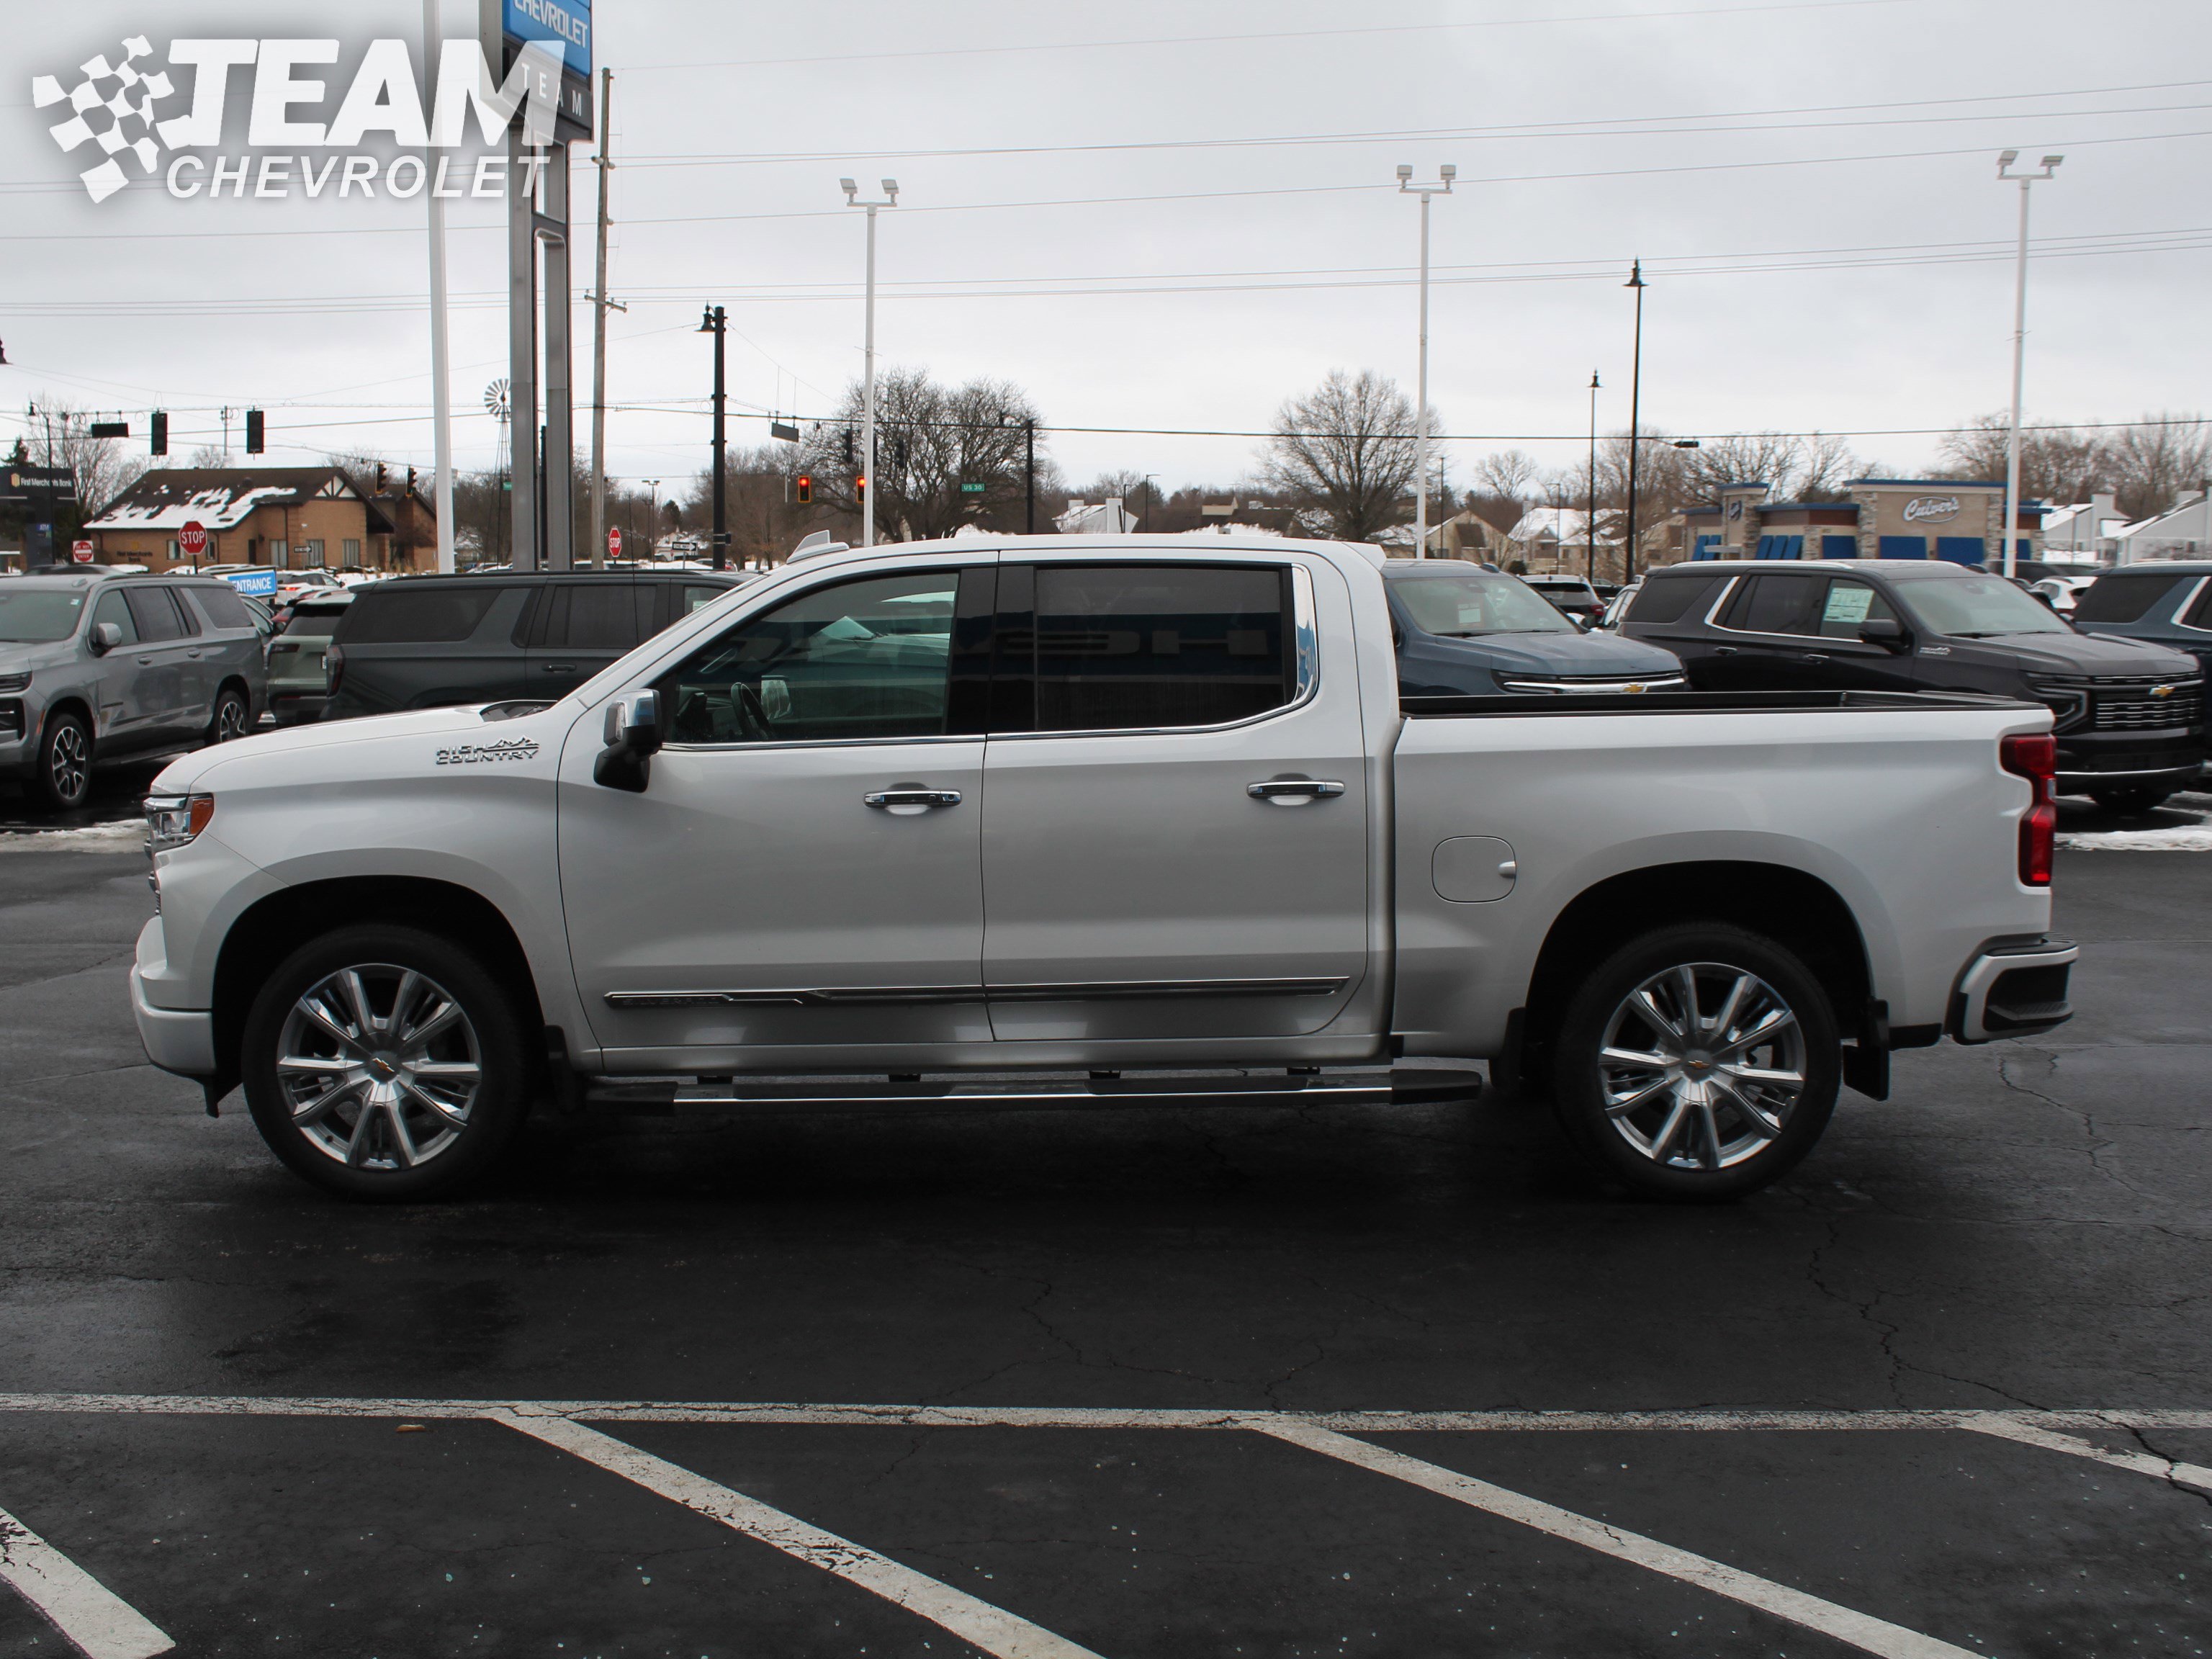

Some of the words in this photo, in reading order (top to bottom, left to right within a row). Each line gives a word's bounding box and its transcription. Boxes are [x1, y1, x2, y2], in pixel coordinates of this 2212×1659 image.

[1903, 497, 1960, 521] Culver's
[181, 531, 205, 544] STOP
[610, 537, 620, 548] STOP
[436, 744, 488, 756] HIGH
[436, 750, 539, 765] COUNTRY
